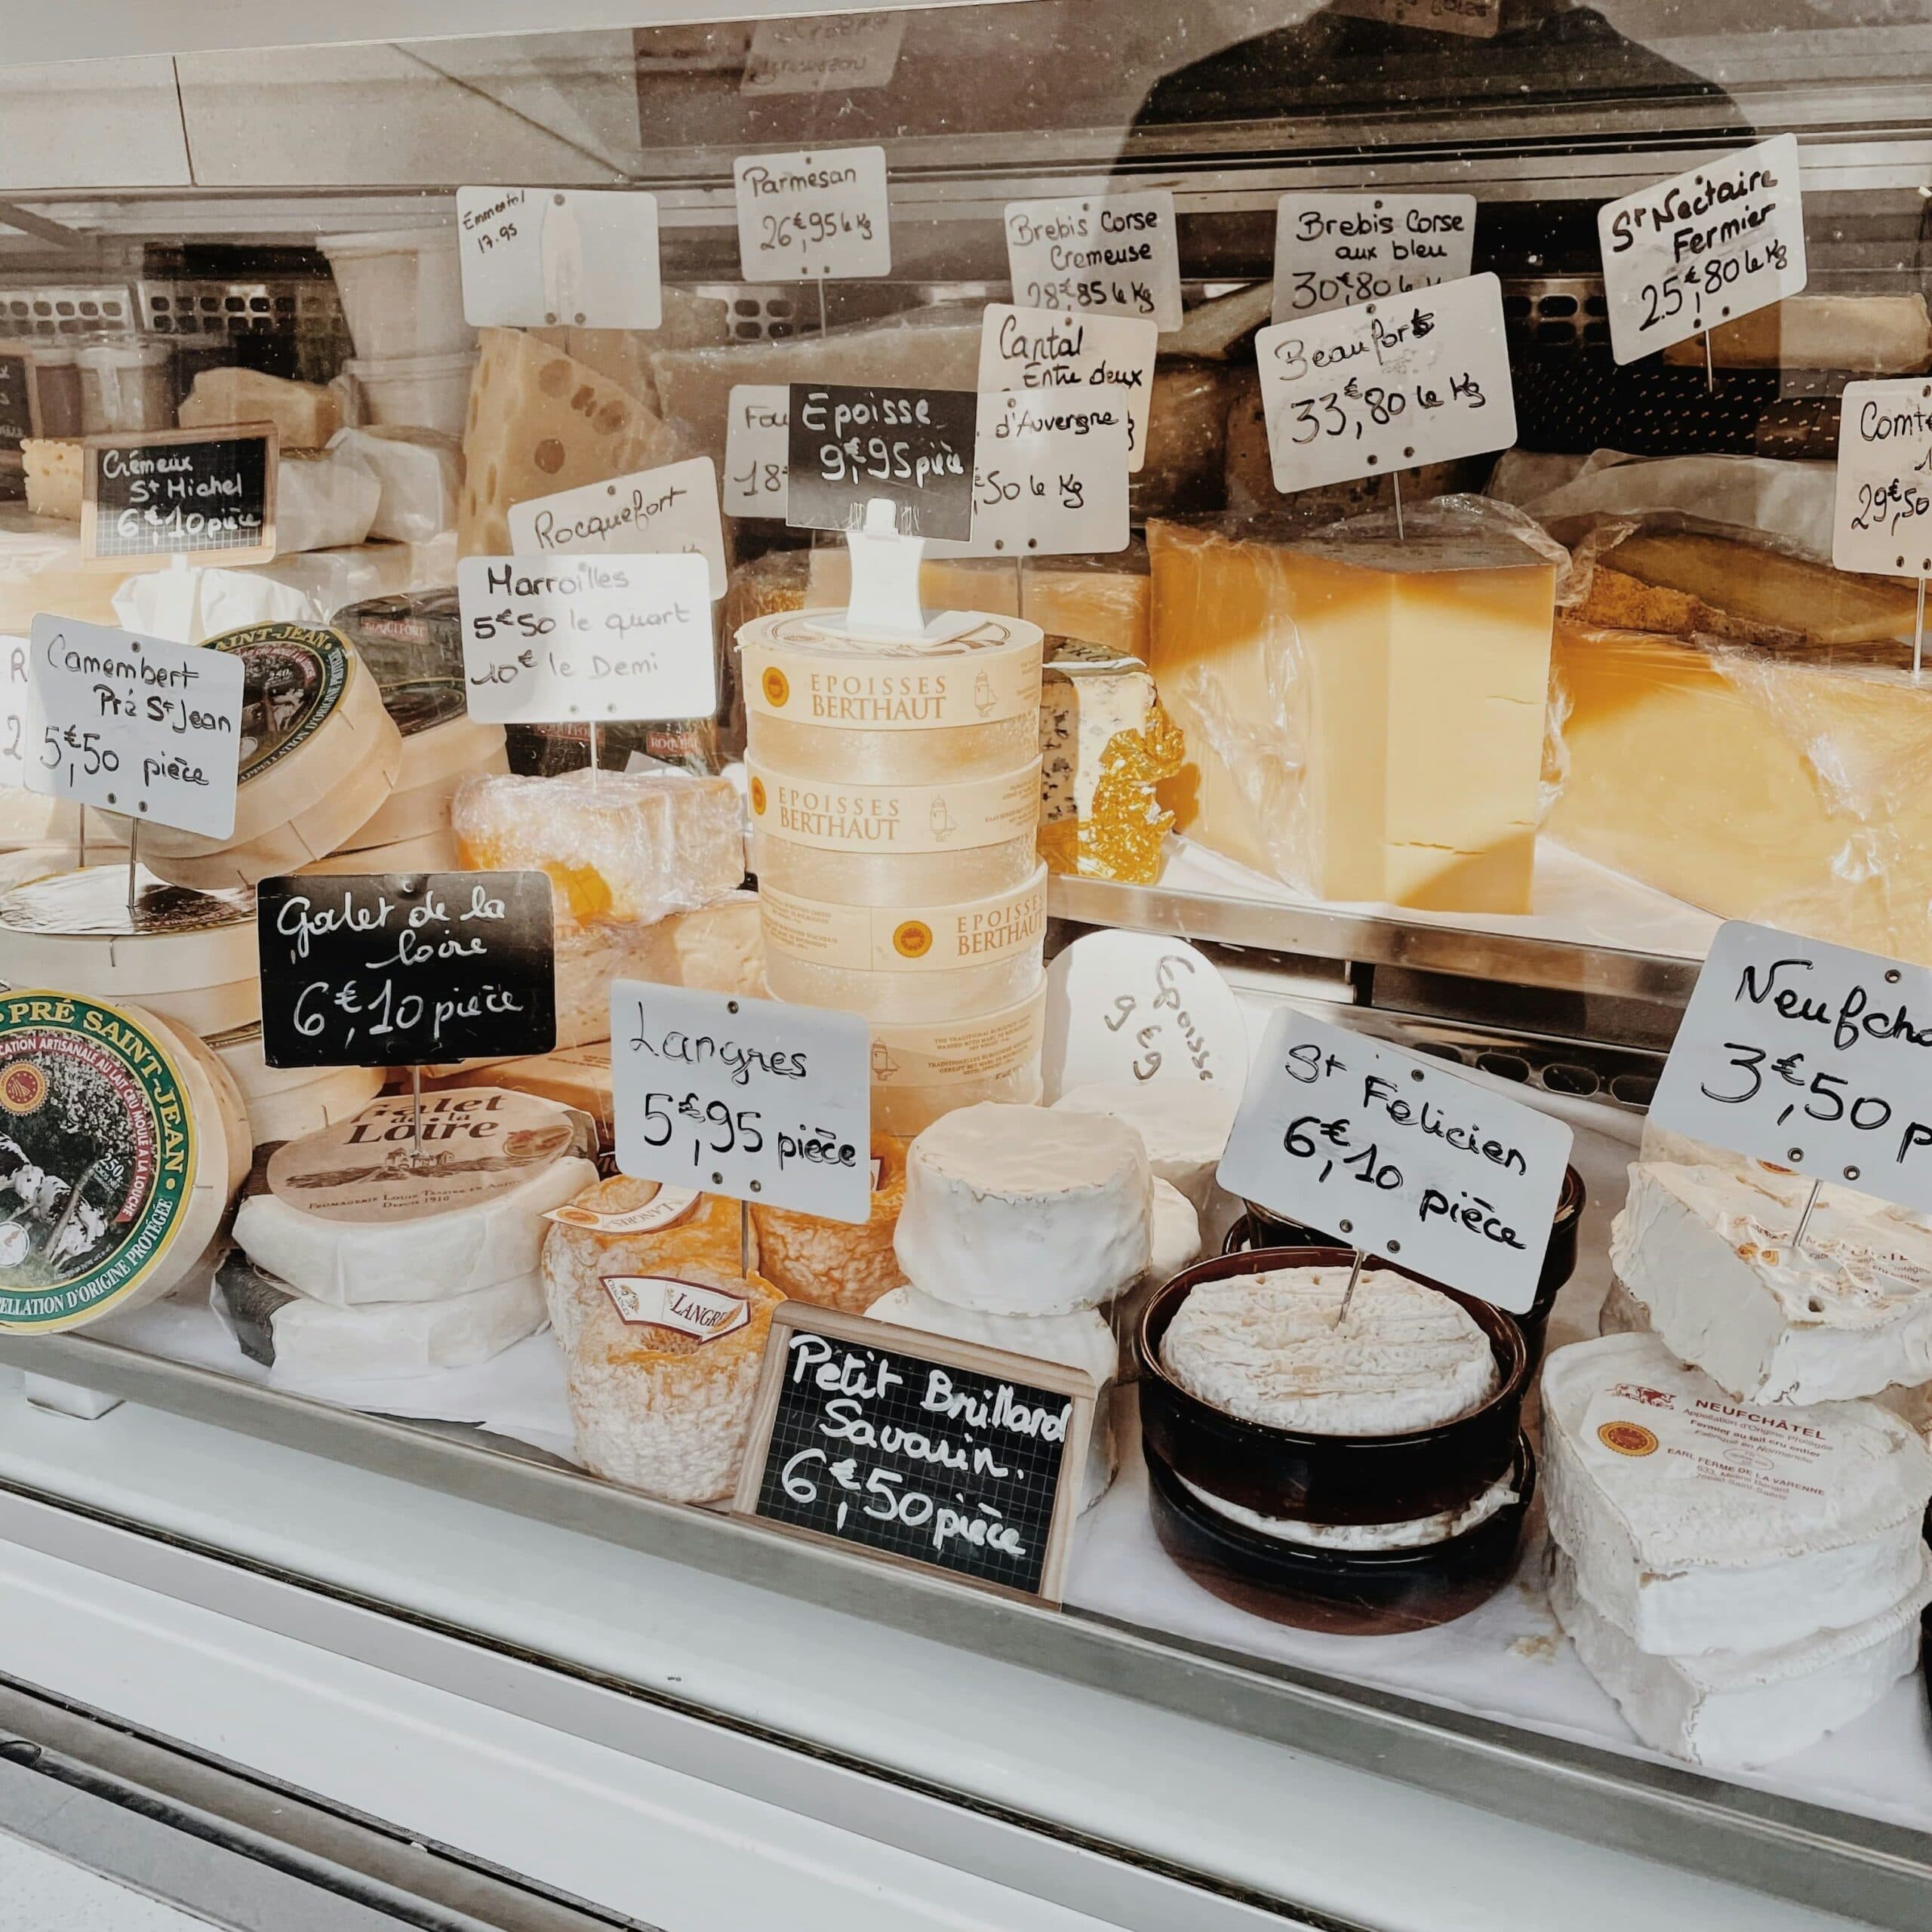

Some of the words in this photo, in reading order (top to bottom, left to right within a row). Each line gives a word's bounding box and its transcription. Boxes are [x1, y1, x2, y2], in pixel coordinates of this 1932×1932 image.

[743, 167, 856, 197] Parmesan
[1653, 170, 1778, 232] Nectaire
[1010, 214, 1088, 246] Brebis
[1101, 211, 1158, 232] Corse
[1296, 211, 1393, 241] Brebis
[1407, 209, 1464, 233] Corse
[1674, 203, 1776, 263] Fermier
[1335, 246, 1377, 260] aux
[1392, 239, 1447, 260] bleu
[1000, 314, 1083, 360] Cantal
[1274, 308, 1435, 380] Beaufort
[1089, 360, 1143, 389] deux
[802, 391, 931, 439] Epoisse
[995, 411, 1118, 438] d'Auvergne
[168, 472, 242, 498] Michel
[571, 609, 592, 631] le
[605, 603, 690, 639] quart
[48, 634, 199, 688] Camembert
[549, 651, 575, 677] le
[589, 652, 658, 680] Demi
[811, 674, 946, 696] EPOISSES
[173, 700, 231, 733] Jean
[811, 695, 946, 721] BERTHAUT
[779, 786, 900, 817] EPOISSES
[780, 806, 900, 841] BERTHAUT
[276, 891, 395, 958] Galet
[408, 890, 451, 929] de
[460, 884, 505, 921] la
[957, 907, 1043, 957] BERTHAUT
[8, 998, 76, 1024] PRÉ
[629, 1001, 808, 1087] Langres
[39, 1038, 97, 1063] ARTISANALE
[122, 1175, 146, 1217] LOUCHE
[342, 1121, 499, 1145] Loire
[68, 1259, 131, 1307] D'ORIGINE
[789, 1334, 903, 1399] Petit
[1696, 1399, 1826, 1441] NEUFCHÂTEL
